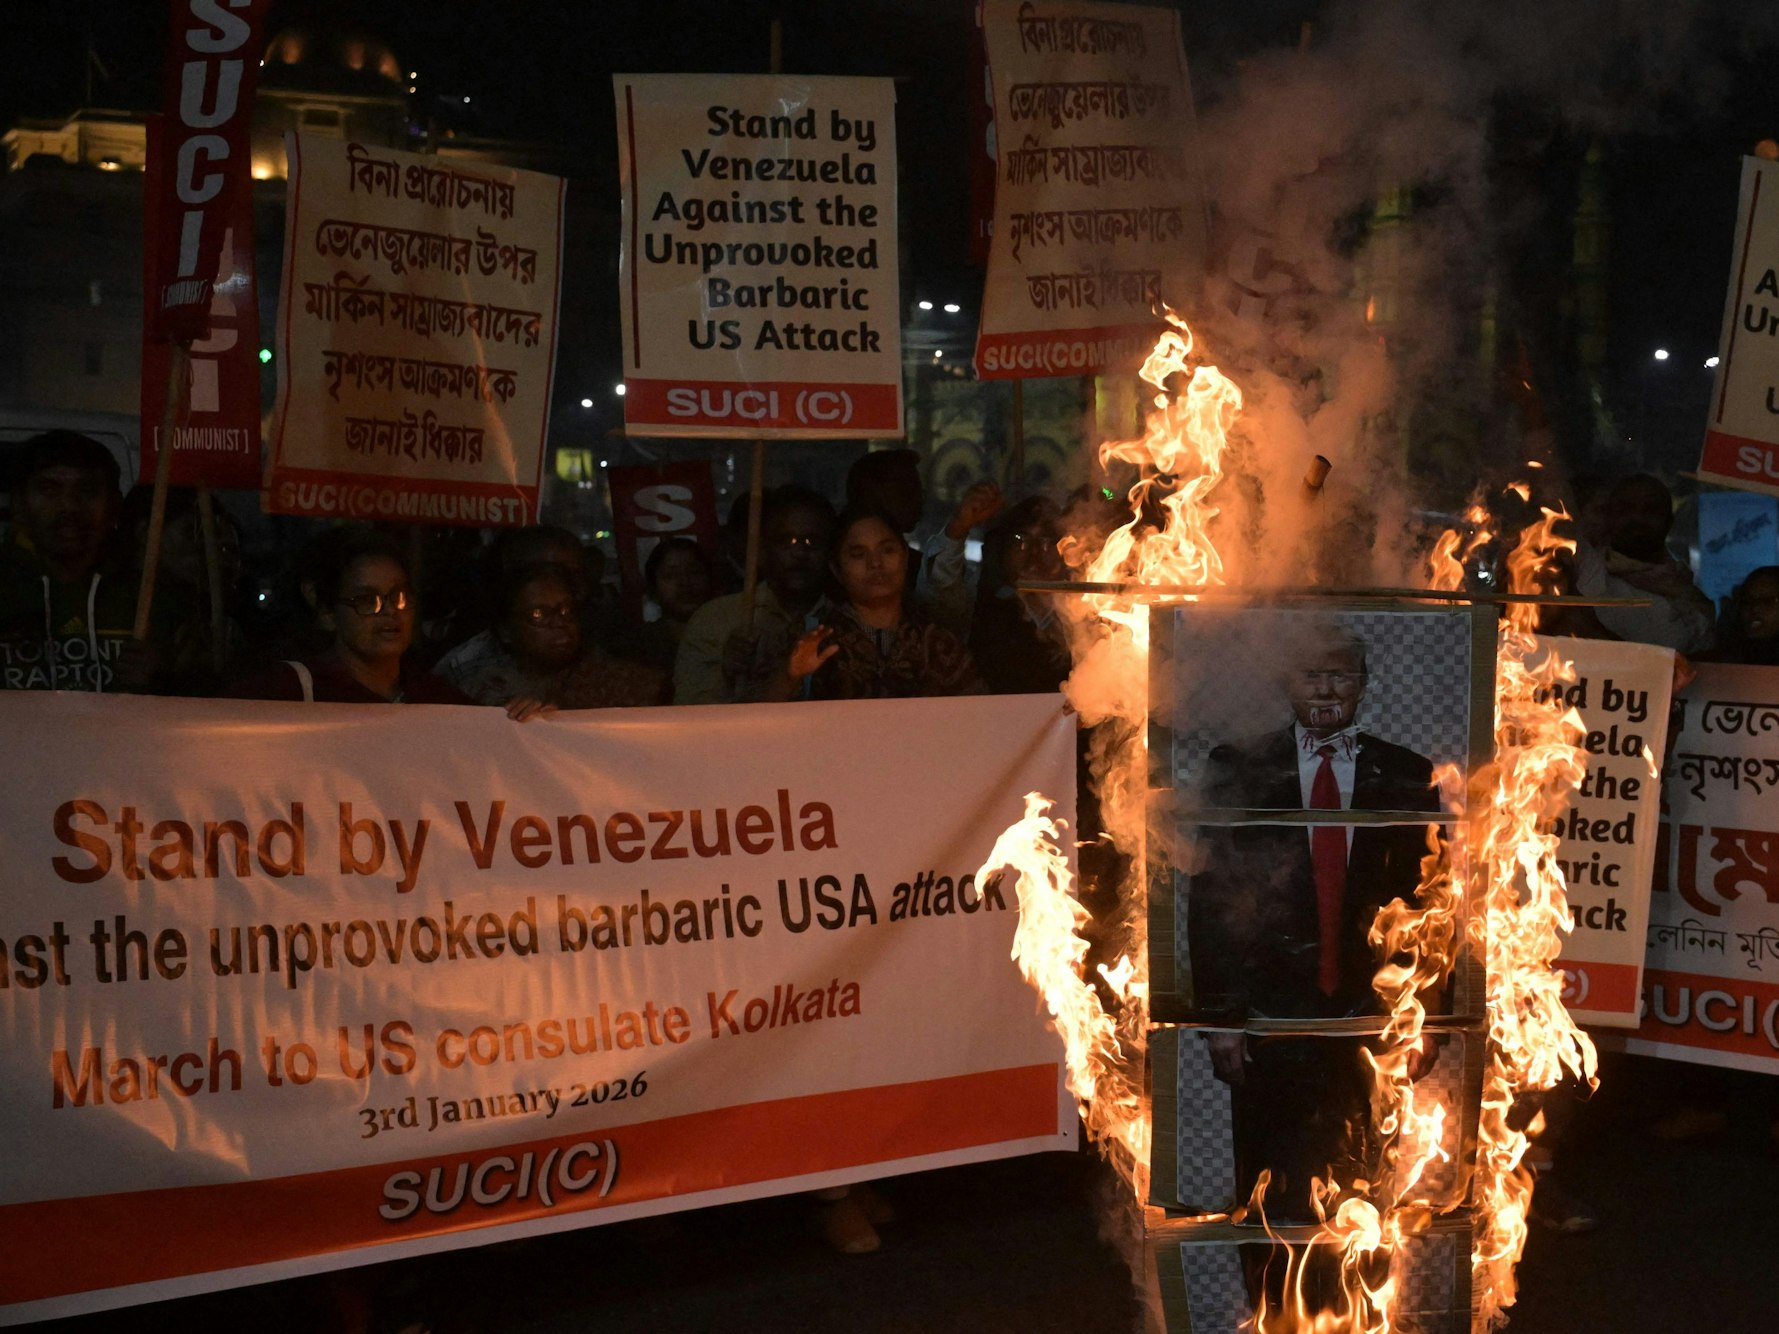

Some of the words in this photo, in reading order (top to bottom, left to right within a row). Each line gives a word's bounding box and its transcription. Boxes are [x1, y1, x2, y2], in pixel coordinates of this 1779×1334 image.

[707, 105, 816, 140] Stand
[830, 109, 877, 152] by
[347, 143, 398, 198] বিনা
[682, 148, 877, 185] Venezuela
[652, 190, 805, 231] Against
[816, 195, 878, 227] the
[316, 219, 472, 276] ভেনেজুয়েলার
[476, 225, 537, 284] উপর
[645, 233, 879, 273] Unprovoked
[304, 271, 386, 326] মার্কিন
[708, 276, 869, 310] Barbaric
[688, 320, 742, 350] US
[754, 320, 881, 352] Attack
[322, 351, 397, 403] নৃশংস
[666, 388, 779, 420] SUCI
[795, 390, 853, 425] (C)
[345, 408, 419, 462] জানাই
[1602, 679, 1649, 723] by
[1579, 767, 1641, 801] the
[51, 799, 305, 884] Stand
[339, 801, 431, 893] by
[453, 789, 838, 870] Venezuela
[90, 915, 188, 984] the
[210, 896, 539, 990] unprovoked
[557, 883, 763, 953] barbaric
[777, 873, 877, 934] USA
[889, 870, 1007, 922] attack
[51, 1036, 242, 1110] March
[262, 1036, 318, 1088] to
[338, 1020, 417, 1080] US
[436, 1001, 692, 1070] consulate
[706, 977, 862, 1039] Kolkata
[359, 1096, 420, 1139] 3rd
[427, 1088, 561, 1132] January
[570, 1070, 649, 1108] 2026
[378, 1139, 618, 1220] SUCI(C)
